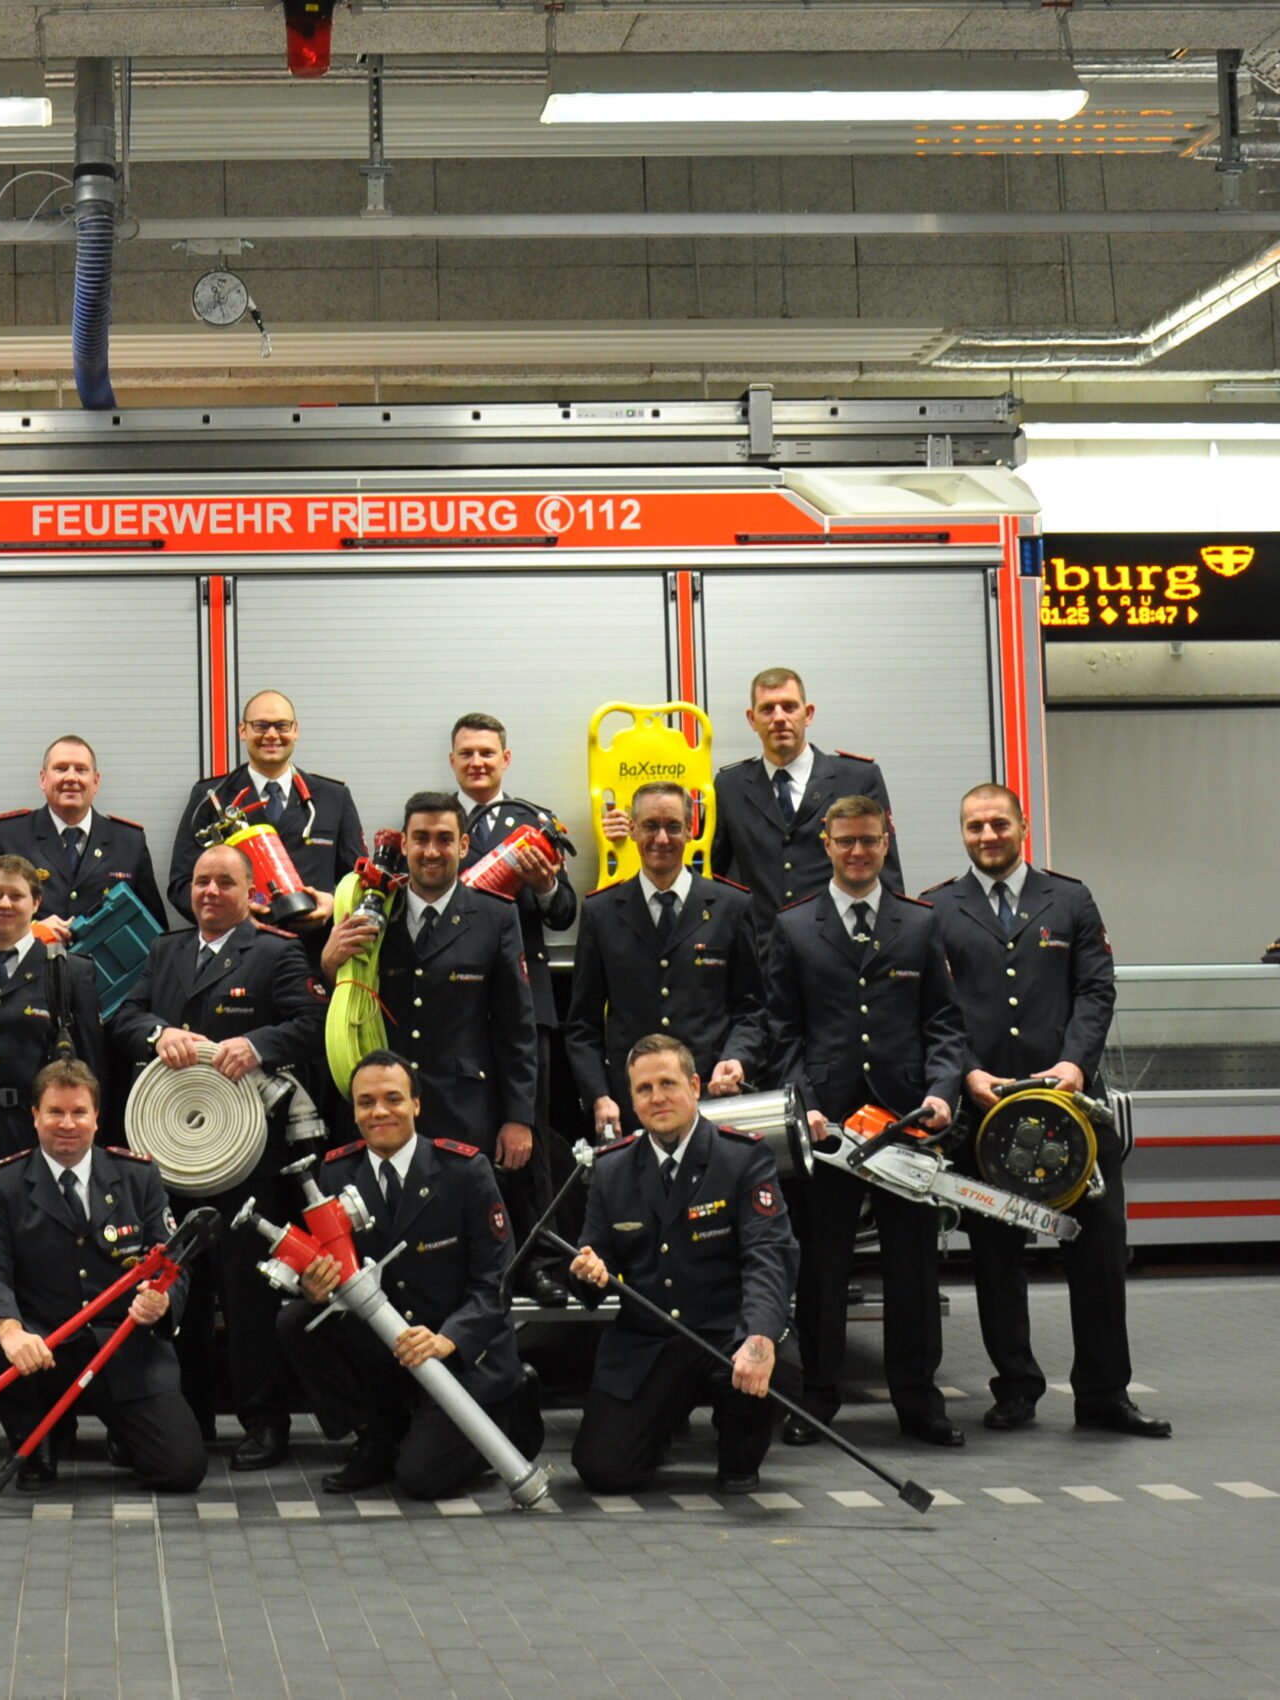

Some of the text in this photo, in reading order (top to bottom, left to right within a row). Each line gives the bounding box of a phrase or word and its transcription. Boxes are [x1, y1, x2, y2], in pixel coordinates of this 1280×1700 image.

[31, 498, 642, 536] FEUERWEHR FREIBURG 112
[1127, 606, 1178, 625] 18:47
[619, 761, 686, 778] BaXstrap
[959, 1187, 996, 1207] STIHL
